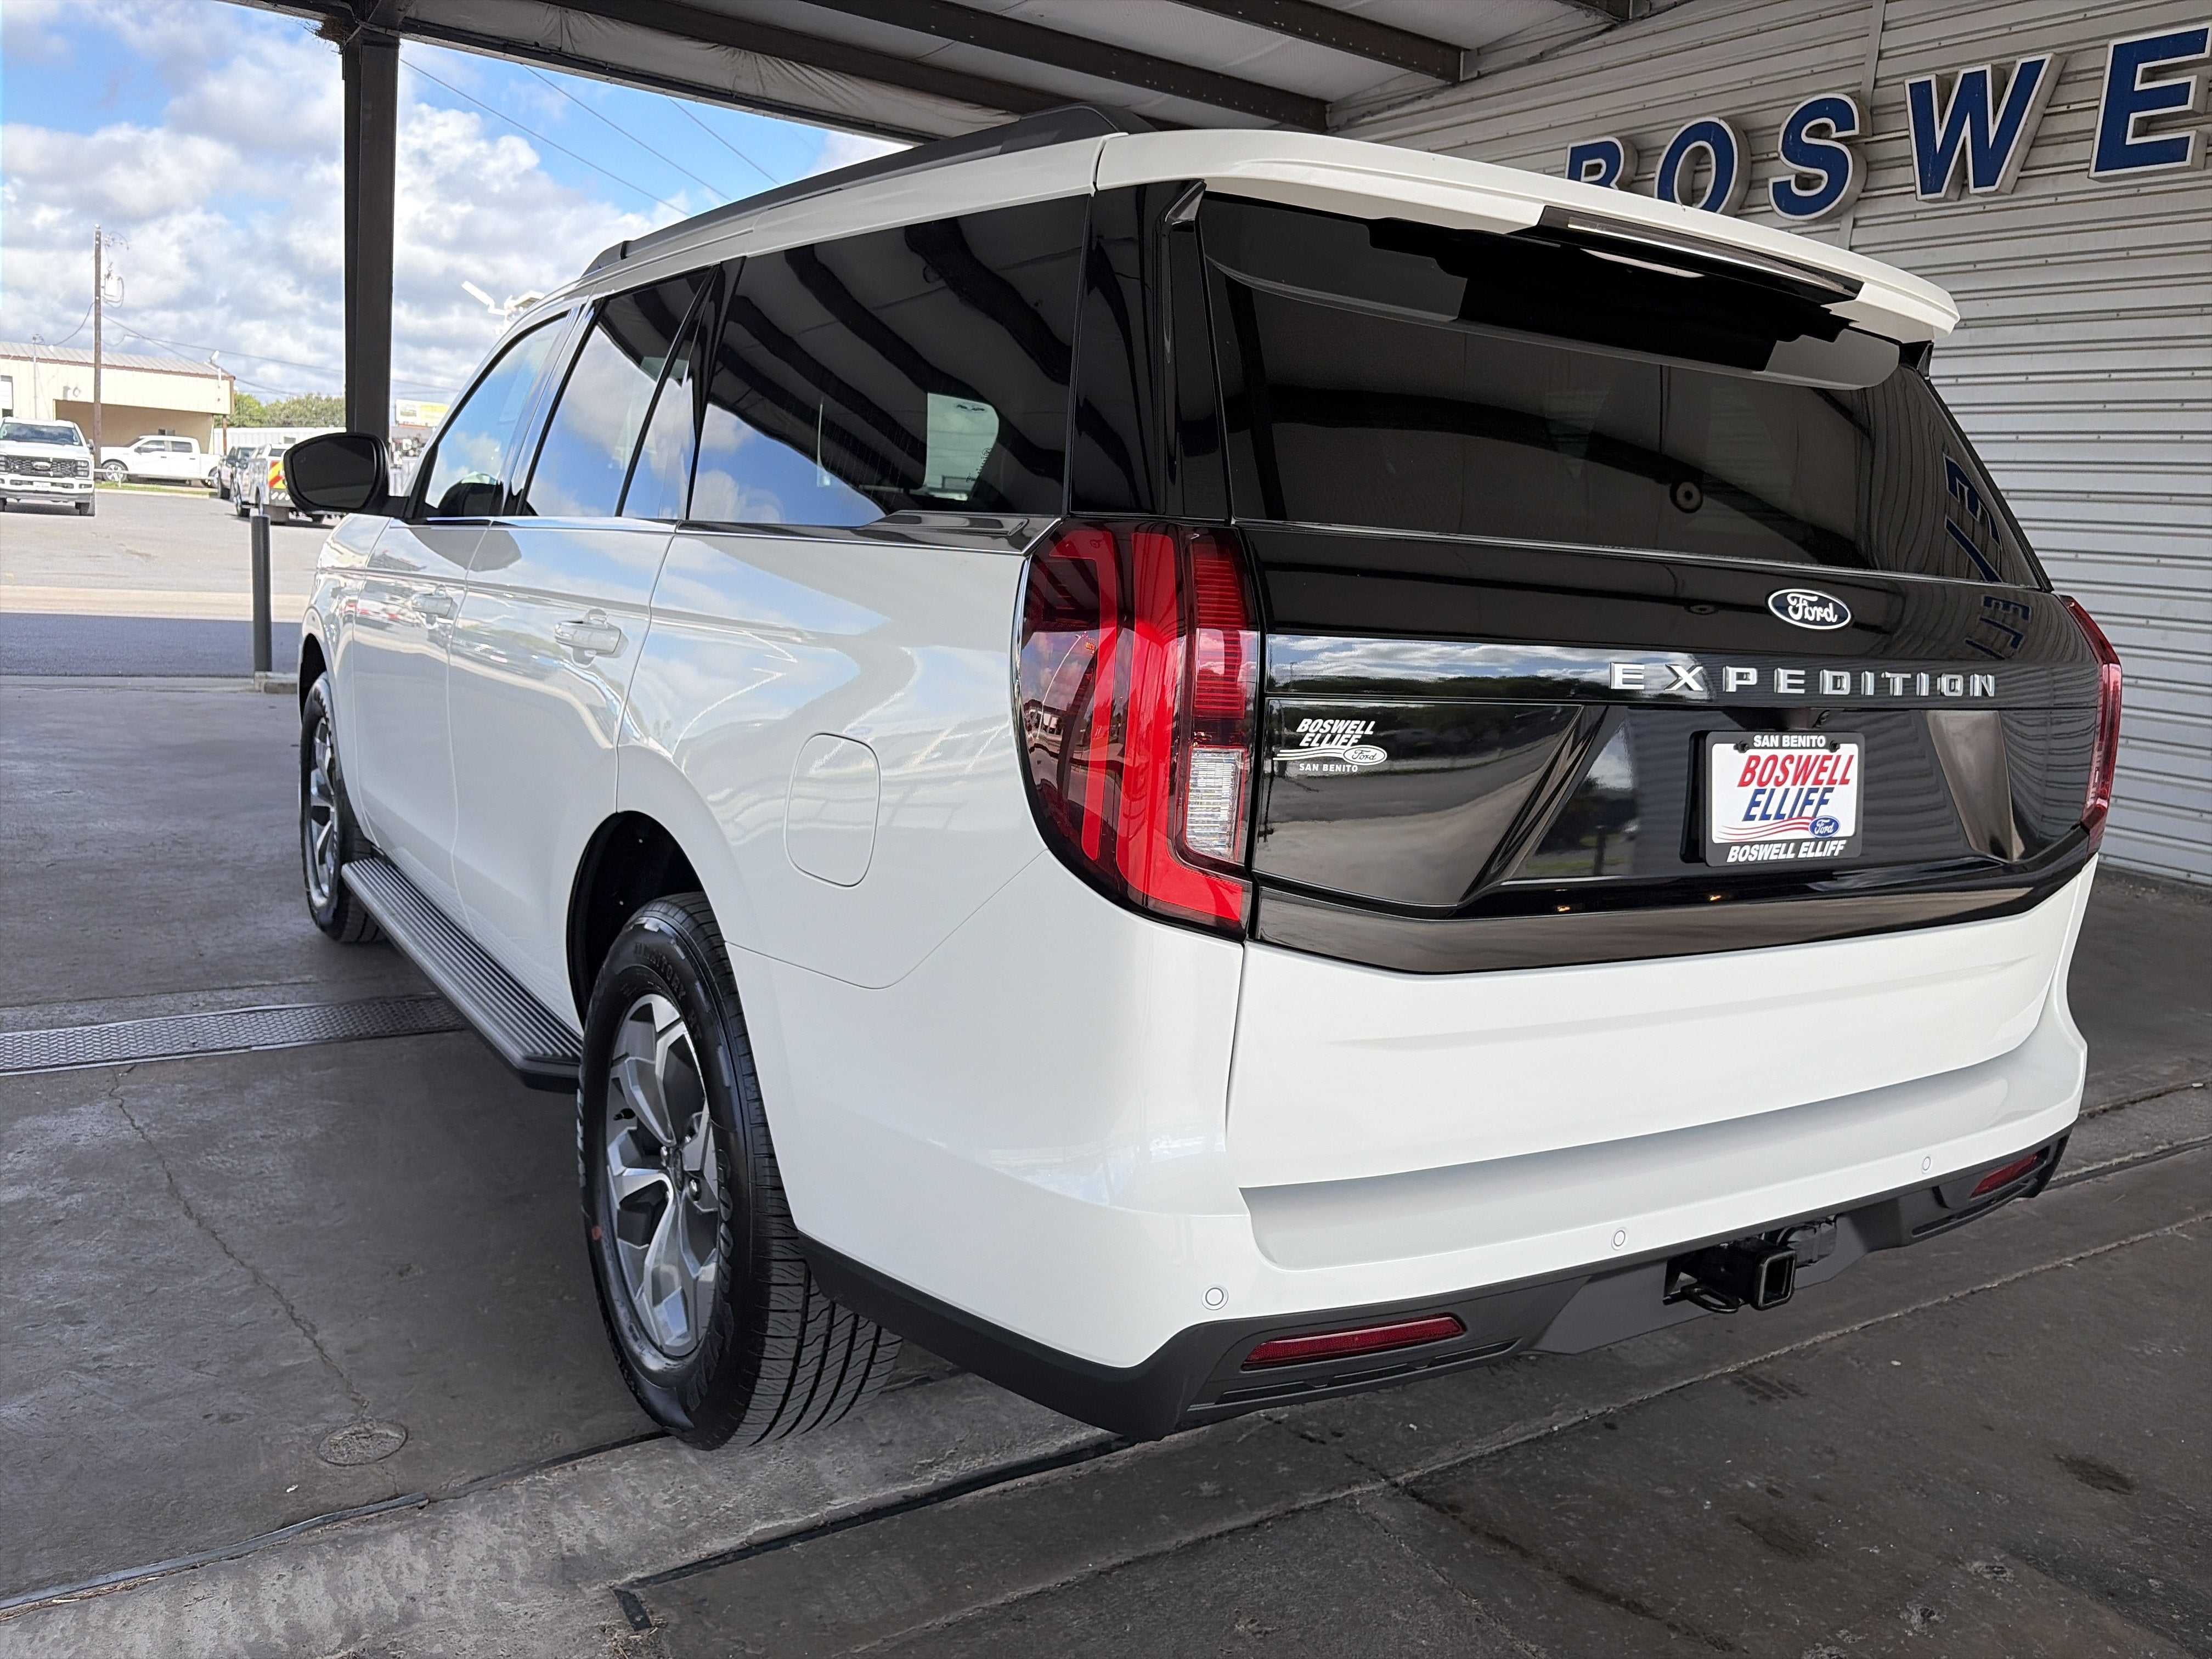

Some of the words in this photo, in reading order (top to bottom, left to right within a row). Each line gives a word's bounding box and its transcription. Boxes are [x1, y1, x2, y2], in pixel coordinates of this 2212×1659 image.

[1787, 593, 1838, 622] Ford
[1609, 662, 1995, 697] EXPEDITION
[1296, 718, 1376, 735] BOSWELL
[1299, 733, 1362, 747] ELLIFF
[1753, 736, 1779, 747] SAN
[1782, 735, 1826, 747] BENITO
[1351, 749, 1377, 761] Ford
[1299, 763, 1319, 772] SAN
[1322, 764, 1358, 772] BENITO
[1737, 754, 1854, 787] BOSWELL
[1741, 787, 1835, 822] ELLIFF
[1814, 819, 1834, 834] Ford
[1726, 843, 1795, 863] BOSWELL
[1797, 839, 1847, 859] ELLIFF
